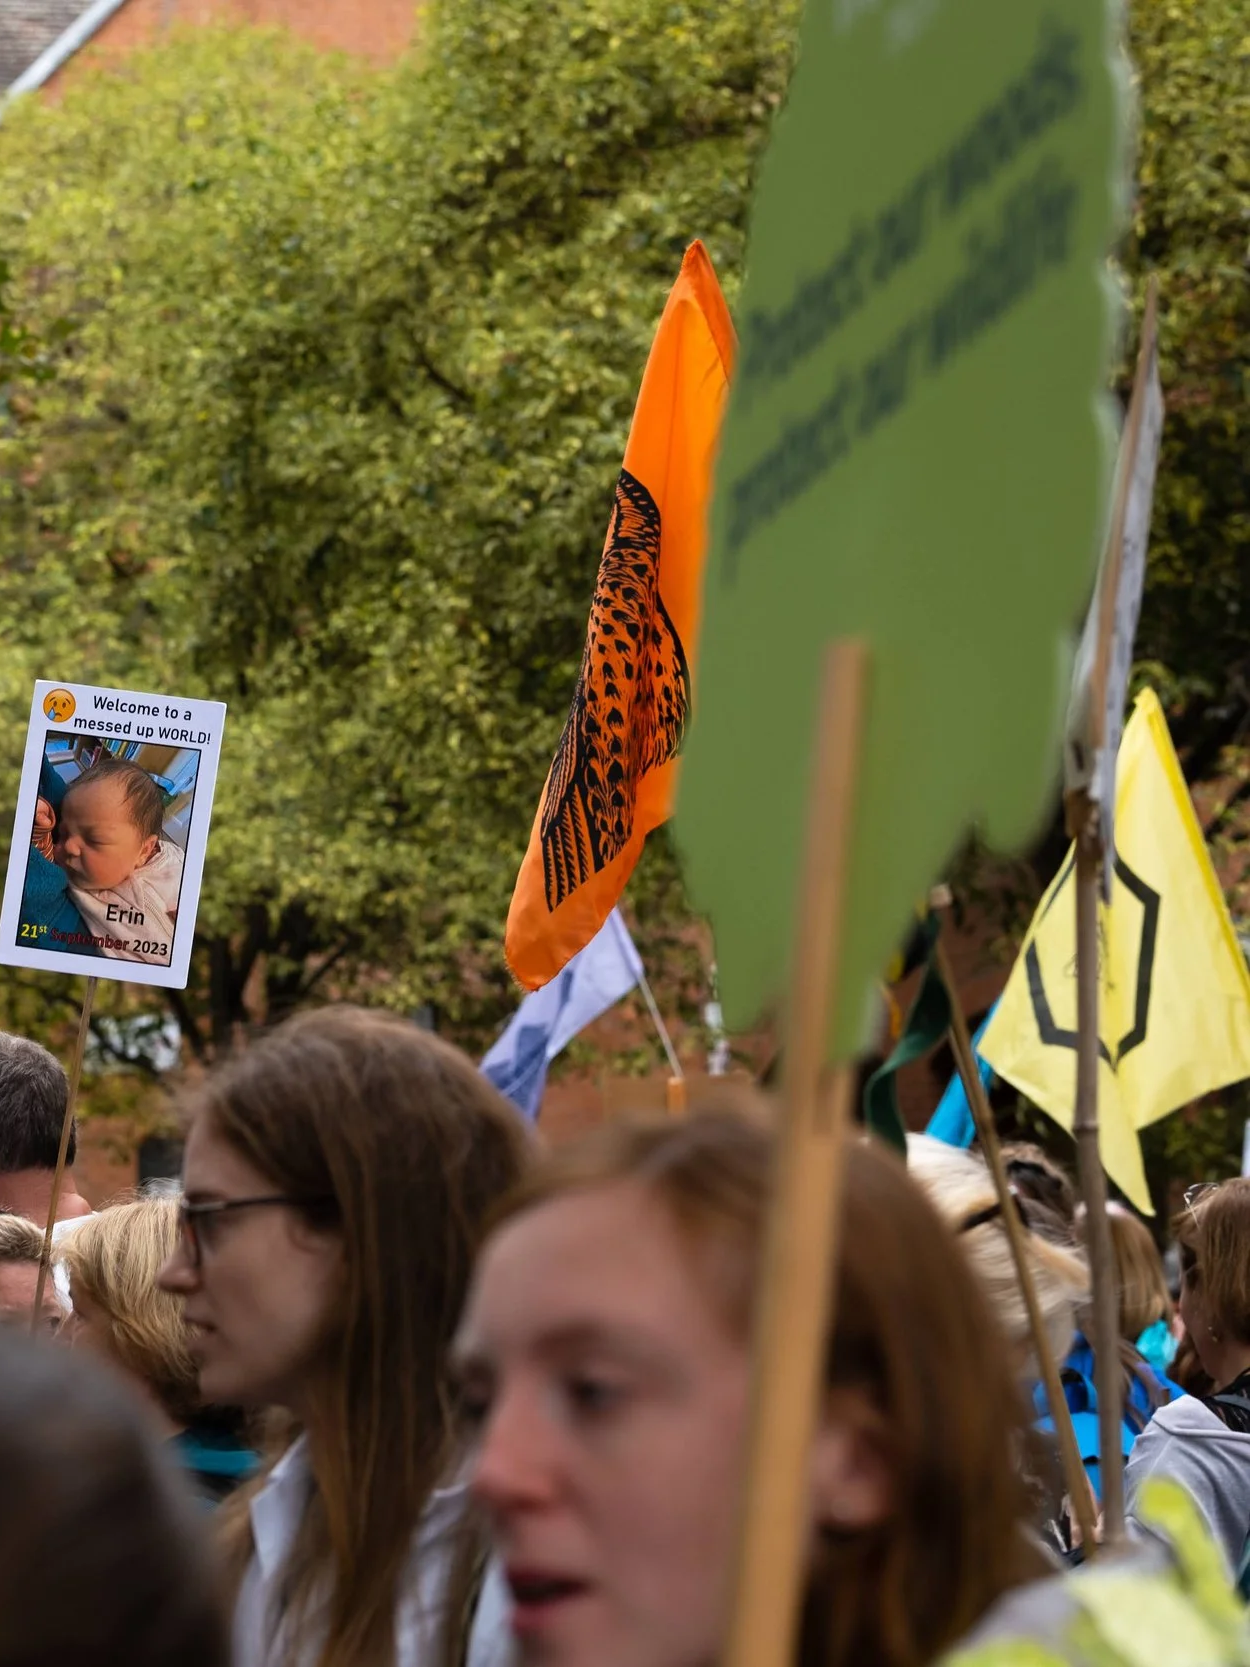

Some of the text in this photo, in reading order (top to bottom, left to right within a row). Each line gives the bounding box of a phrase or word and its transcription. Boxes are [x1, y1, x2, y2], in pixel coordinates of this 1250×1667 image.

[93, 695, 192, 721] Welcome to a
[74, 717, 211, 745] messed up WORLD!
[106, 903, 145, 926] Erin
[20, 923, 168, 957] 21st September 2023
